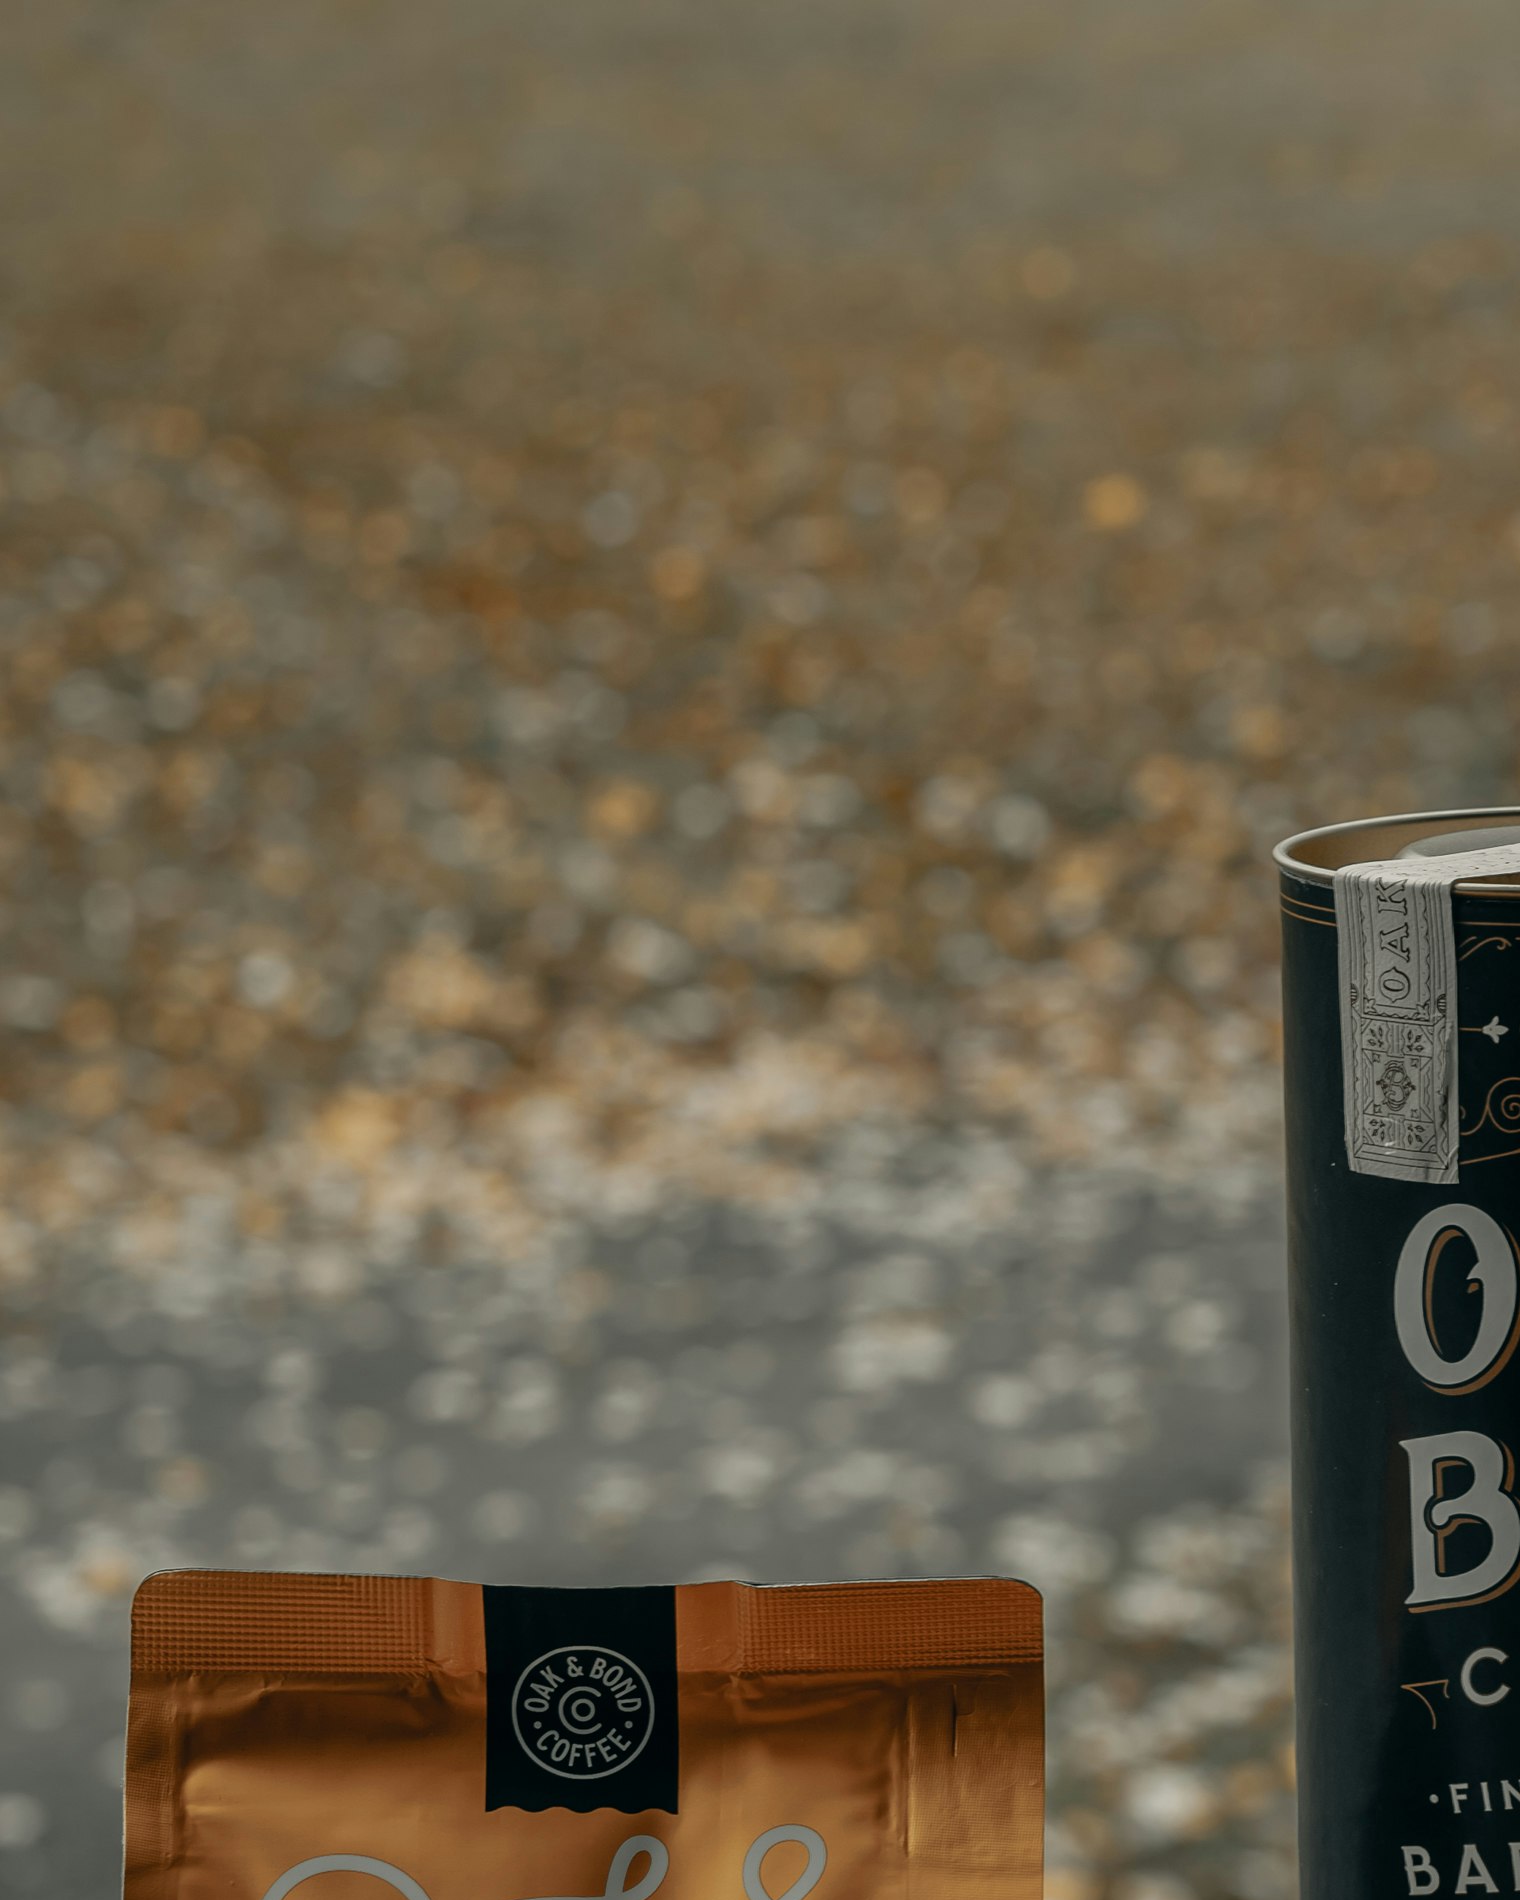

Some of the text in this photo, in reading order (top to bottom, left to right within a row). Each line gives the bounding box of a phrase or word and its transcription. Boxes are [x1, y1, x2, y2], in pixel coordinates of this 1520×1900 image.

[1376, 871, 1411, 1002] OAK
[523, 1656, 642, 1713] OAK & BOND
[536, 1727, 632, 1768] COFFEE
